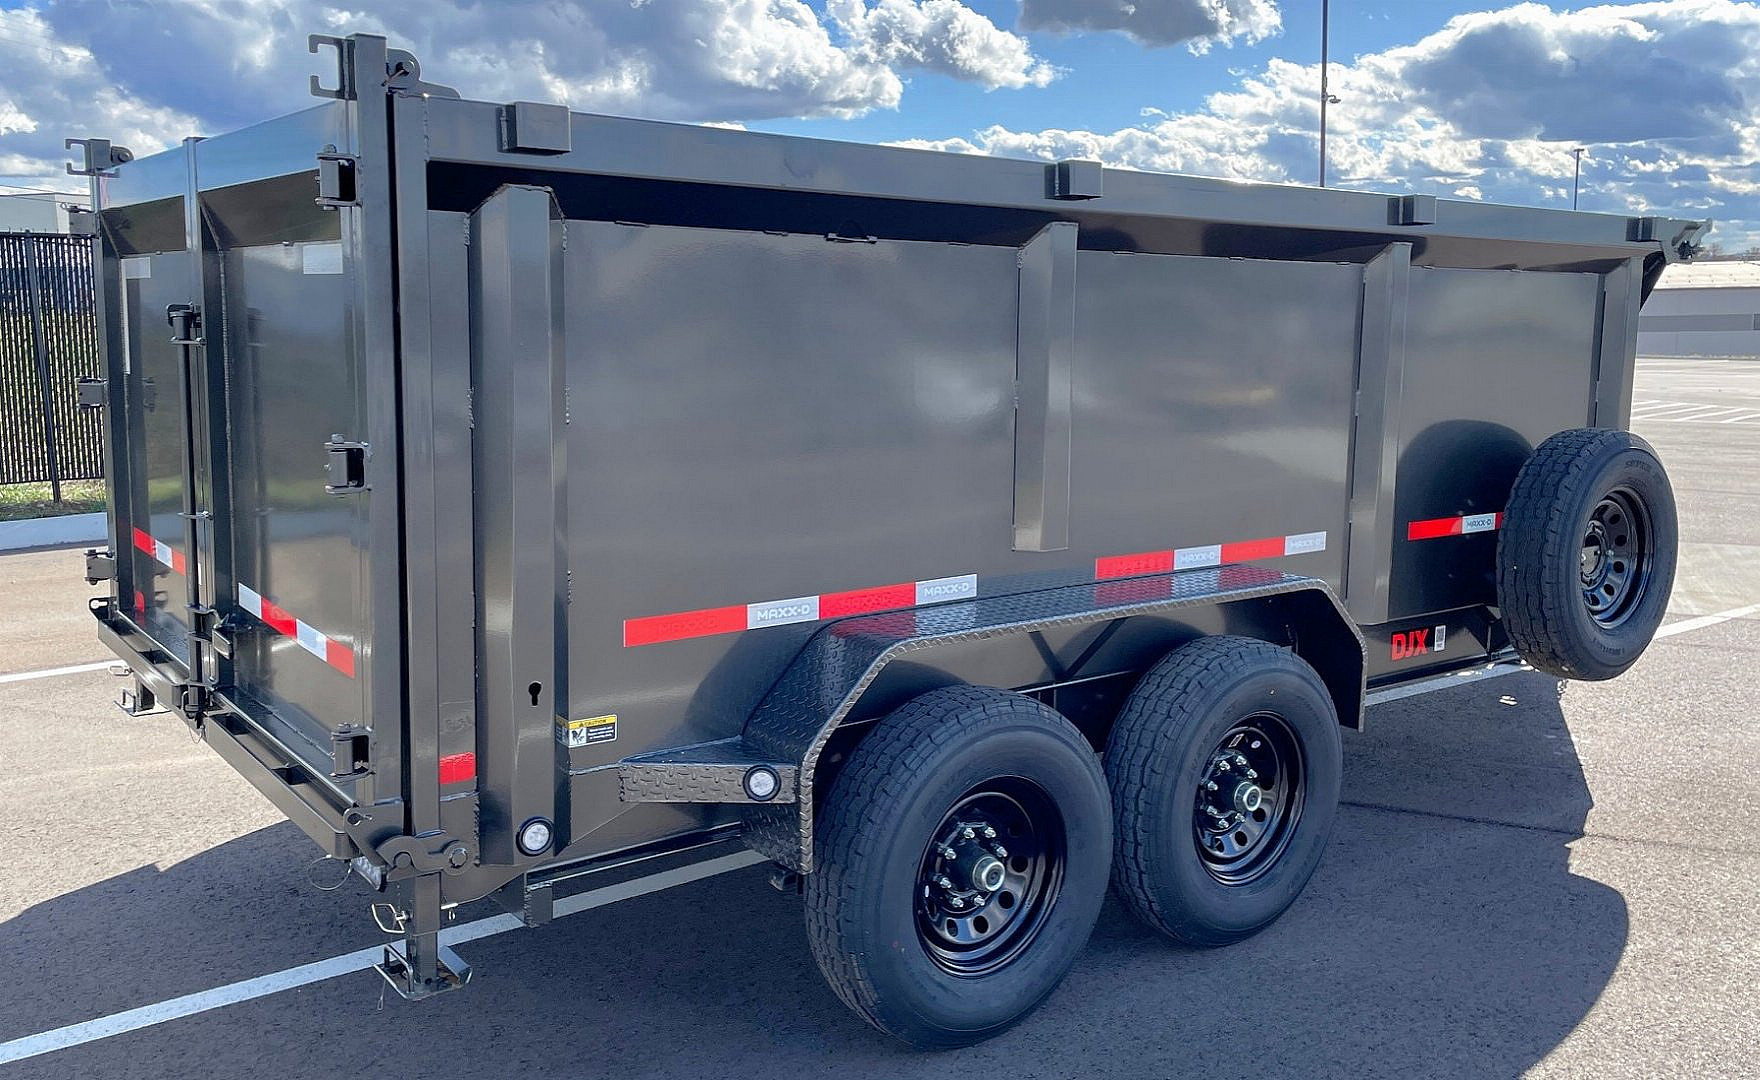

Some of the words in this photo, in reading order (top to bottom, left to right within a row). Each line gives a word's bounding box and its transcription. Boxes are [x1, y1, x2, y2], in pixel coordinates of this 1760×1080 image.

[757, 604, 810, 621] MAXX-D
[924, 582, 969, 597] MAXX-D
[1391, 629, 1429, 660] DJX
